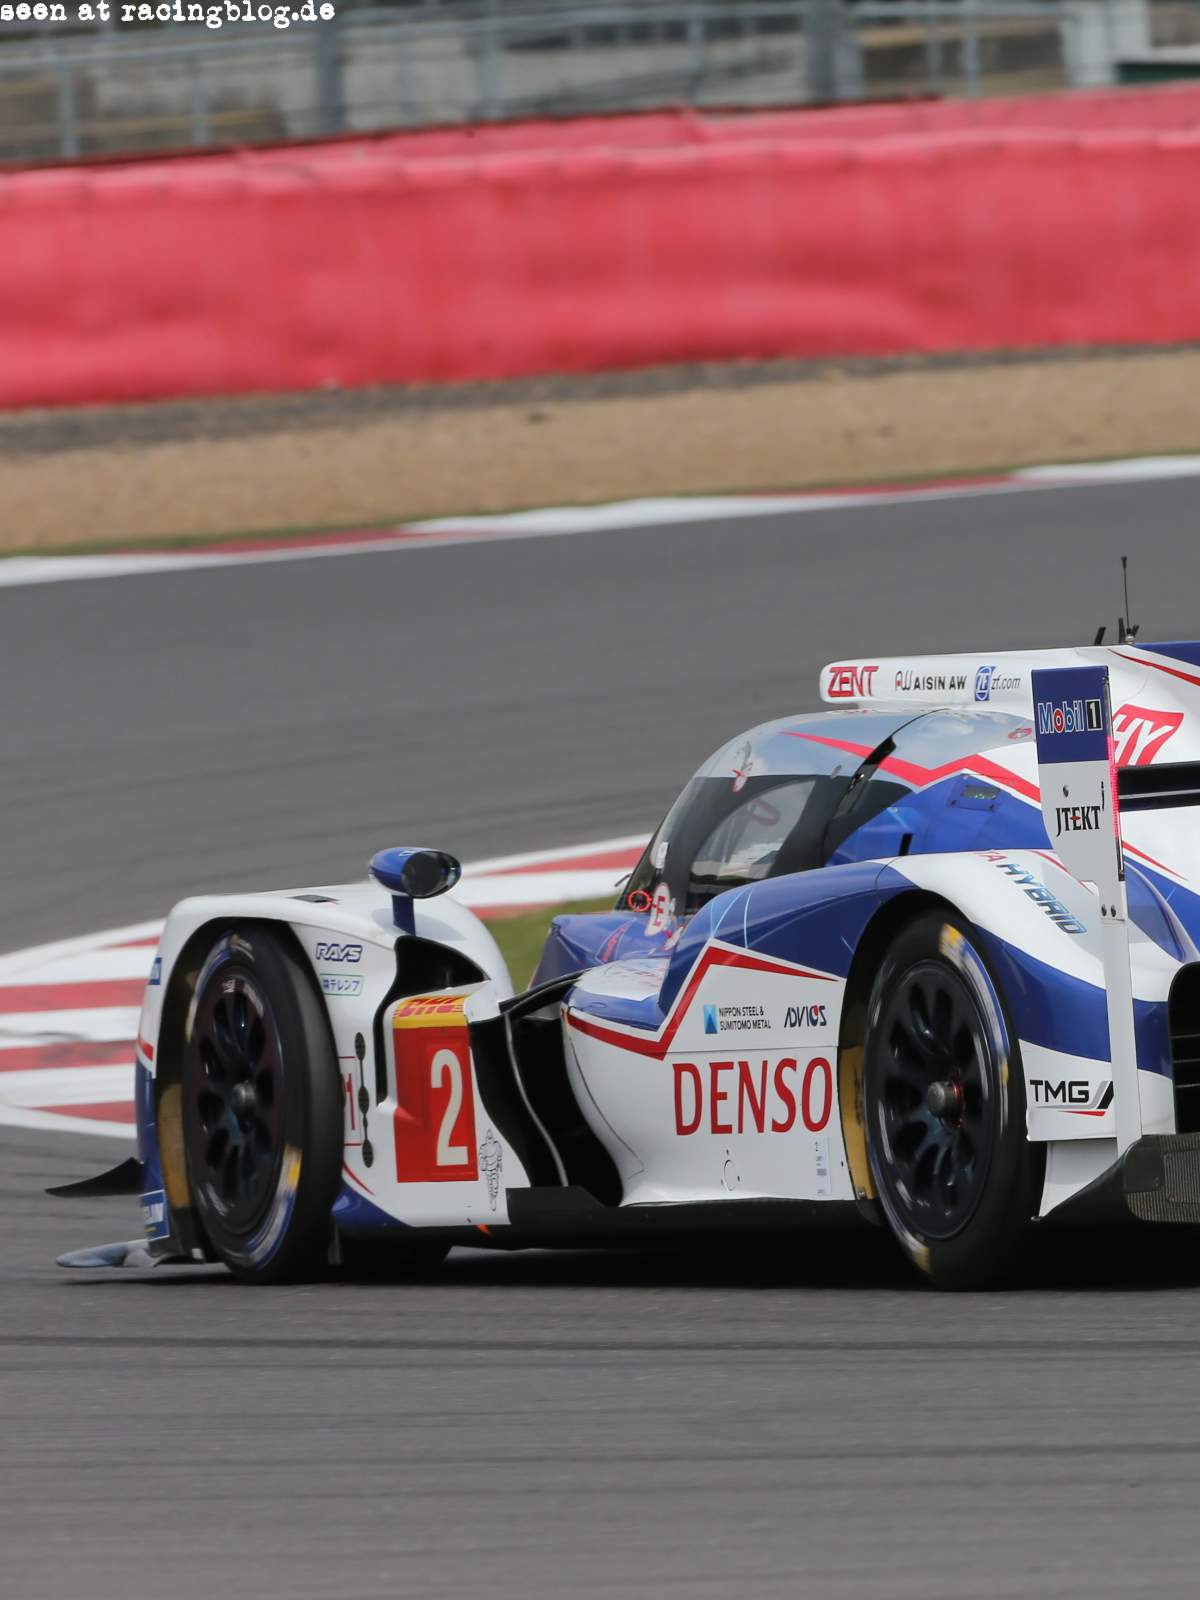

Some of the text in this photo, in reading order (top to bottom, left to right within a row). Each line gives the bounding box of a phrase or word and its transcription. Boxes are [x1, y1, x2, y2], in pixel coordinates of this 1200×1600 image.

[827, 665, 879, 698] ZENT
[913, 676, 946, 691] AISIN
[948, 675, 967, 690] AW
[991, 673, 1021, 691] zf.com
[1037, 700, 1102, 735] Mobil 1
[1056, 806, 1100, 837] JTEKT
[996, 863, 1087, 934] HYBRID
[316, 942, 363, 963] RAYS
[719, 1006, 764, 1017] NIPPON STEEL &
[784, 1005, 827, 1028] ADVICS
[720, 1019, 771, 1031] SUMITOMO METAL
[672, 1056, 833, 1136] DENSO
[1029, 1079, 1090, 1103] TMG
[430, 1048, 469, 1167] 2
